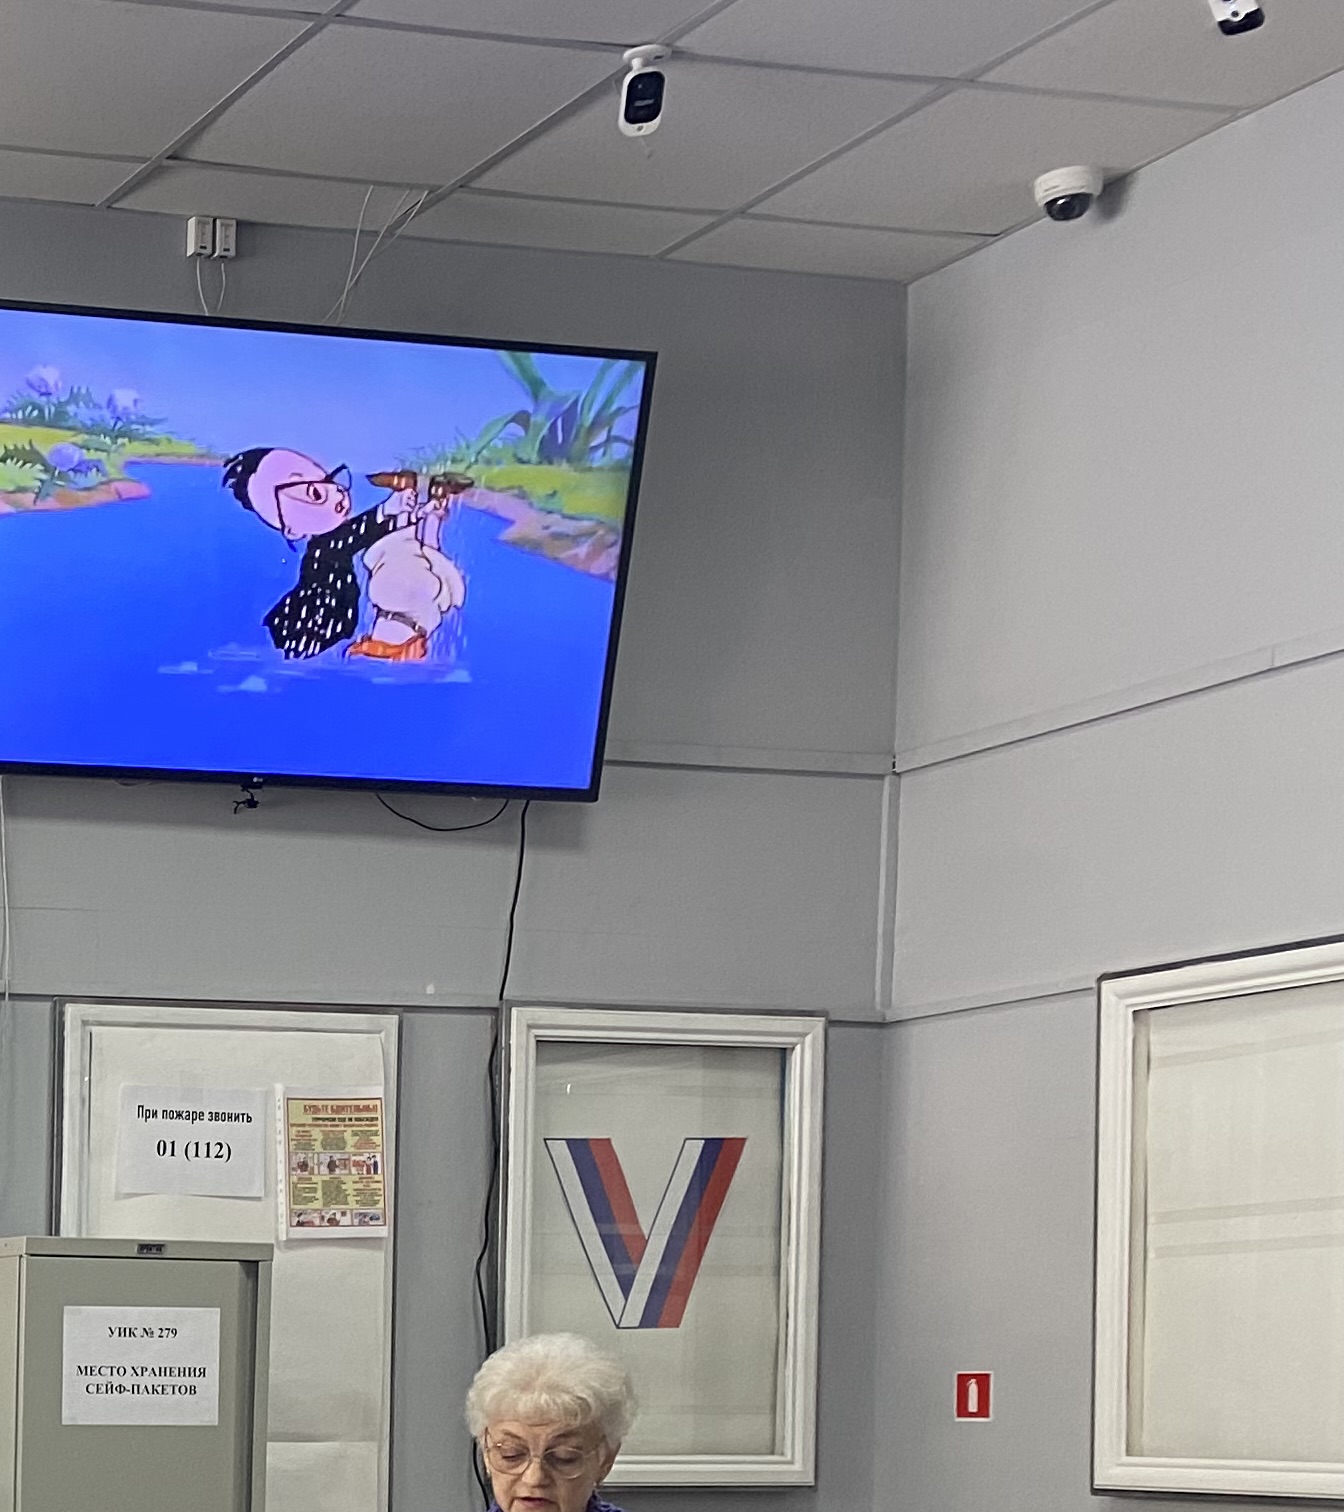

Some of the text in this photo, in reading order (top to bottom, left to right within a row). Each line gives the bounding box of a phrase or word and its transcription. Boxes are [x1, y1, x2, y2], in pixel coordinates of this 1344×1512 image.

[137, 1104, 253, 1125] При пожаре звонить
[156, 1139, 232, 1163] 01 (112)
[108, 1326, 178, 1338] УИК № 279
[76, 1365, 207, 1378] МЕСТО ХРАНЕНИЯ
[85, 1381, 197, 1395] СЕЙФ-ПАКЕТОВ
